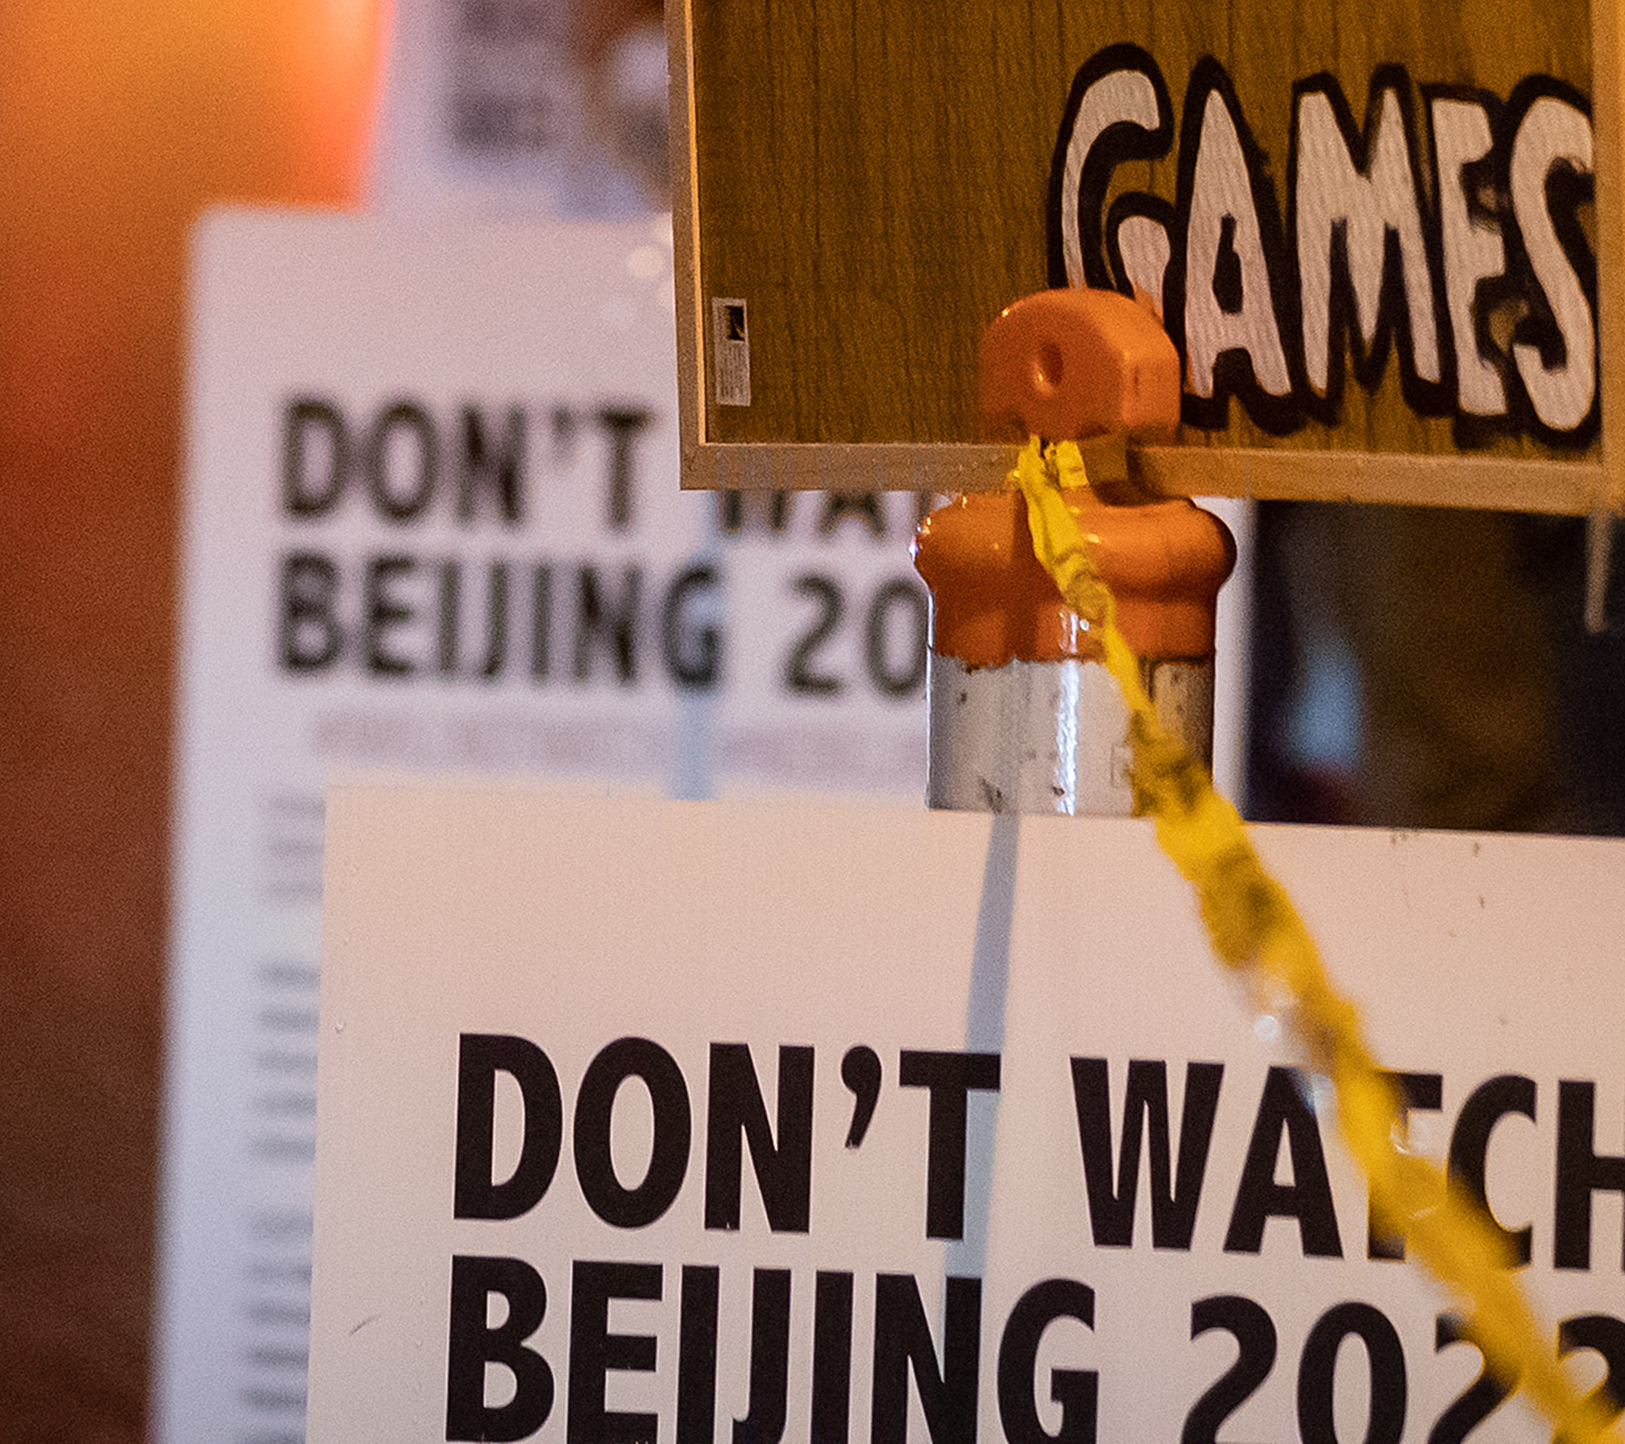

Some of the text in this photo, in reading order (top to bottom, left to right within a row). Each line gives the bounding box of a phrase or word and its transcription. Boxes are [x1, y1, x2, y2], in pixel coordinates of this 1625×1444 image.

[1048, 43, 1601, 444] GAMES
[281, 395, 652, 527] DON'T
[278, 551, 927, 699] BEIJING 20
[445, 1255, 1102, 1444] BEIJING
